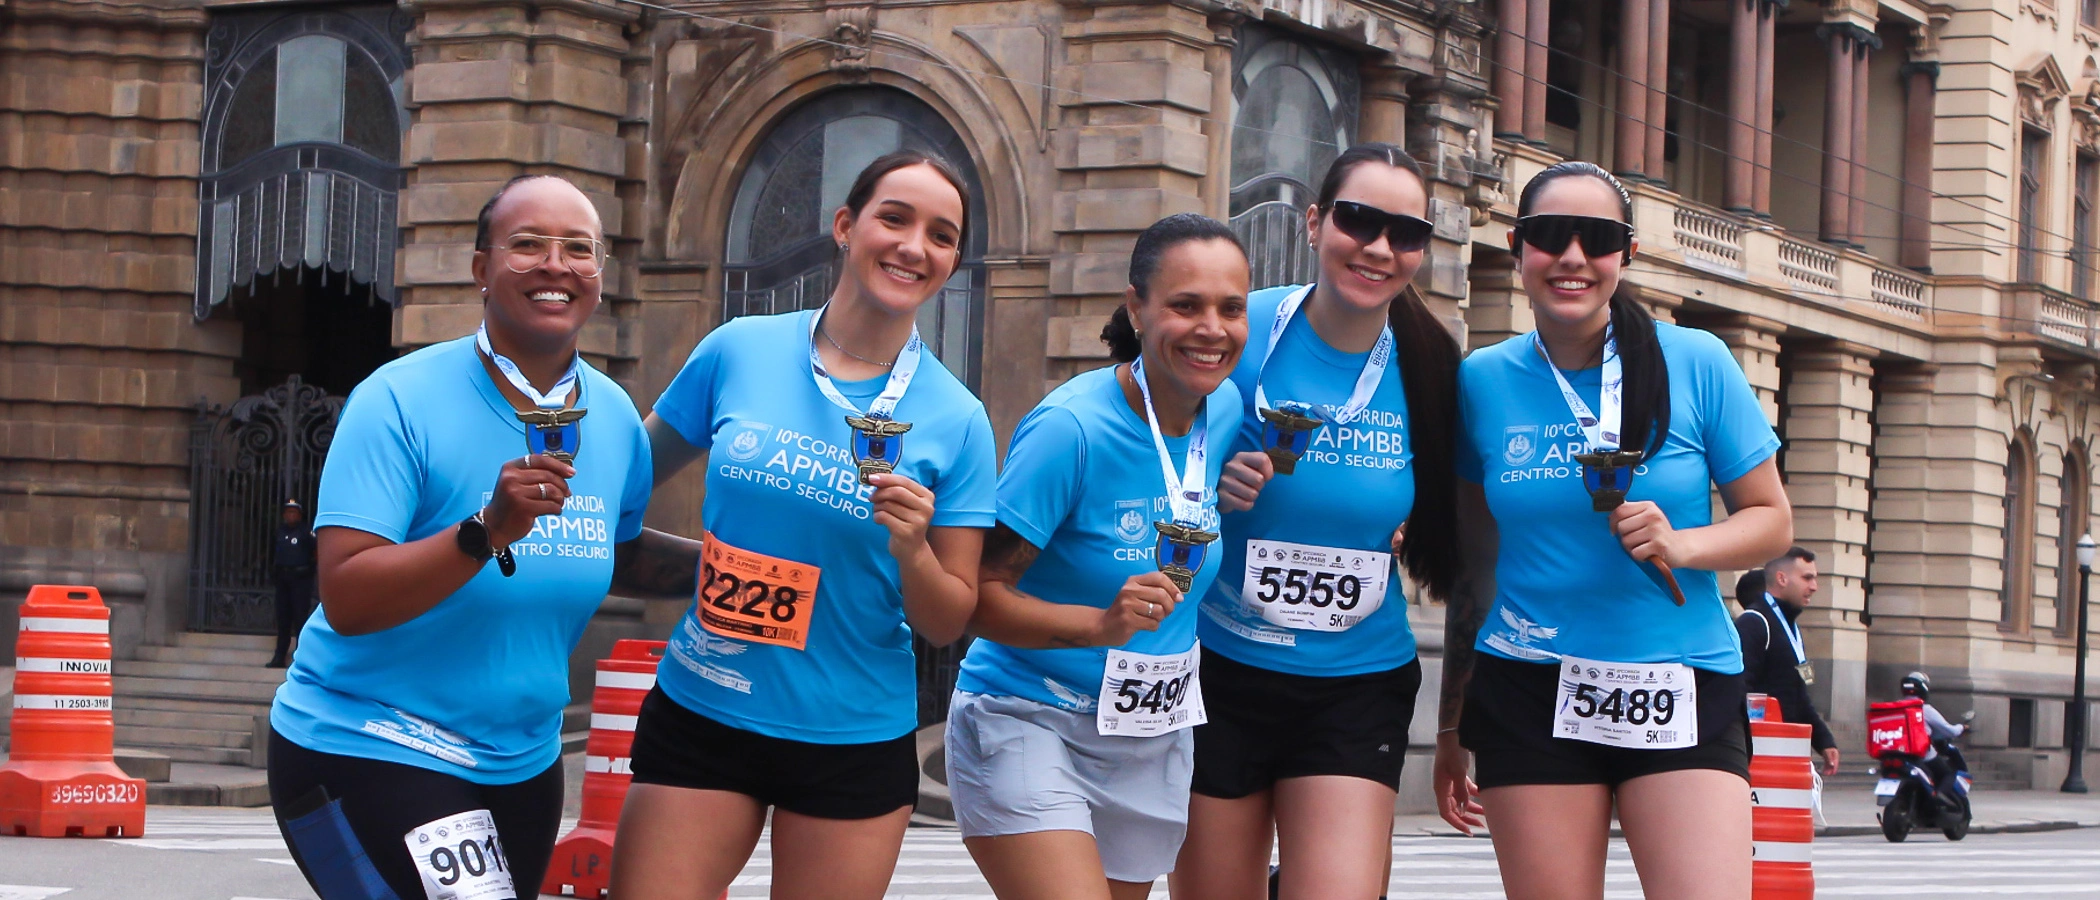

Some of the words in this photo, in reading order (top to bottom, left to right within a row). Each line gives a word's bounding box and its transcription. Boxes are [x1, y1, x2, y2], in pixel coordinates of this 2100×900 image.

[1313, 425, 1403, 455] APMBB
[798, 435, 858, 468] CORRI
[1304, 450, 1340, 465] TRO
[1345, 453, 1406, 470] SEGURO
[1500, 466, 1570, 483] CENTRO
[719, 464, 791, 490] CENTRO
[795, 483, 869, 520] SEGURO
[561, 495, 605, 513] RRIDA
[526, 515, 607, 542] APMBB
[509, 543, 552, 556] NTRO
[556, 543, 609, 560] SEGURO
[1113, 548, 1157, 561] CENT
[702, 562, 798, 623] 2228
[1257, 566, 1361, 611] 5559
[1329, 614, 1344, 628] 5K
[762, 626, 777, 639] 10K
[60, 661, 108, 673] INNOVIA
[1114, 672, 1191, 714] 5490
[54, 700, 64, 709] 11
[1573, 683, 1674, 725] 5489
[1646, 730, 1659, 744] 5K
[430, 835, 508, 886] 901
